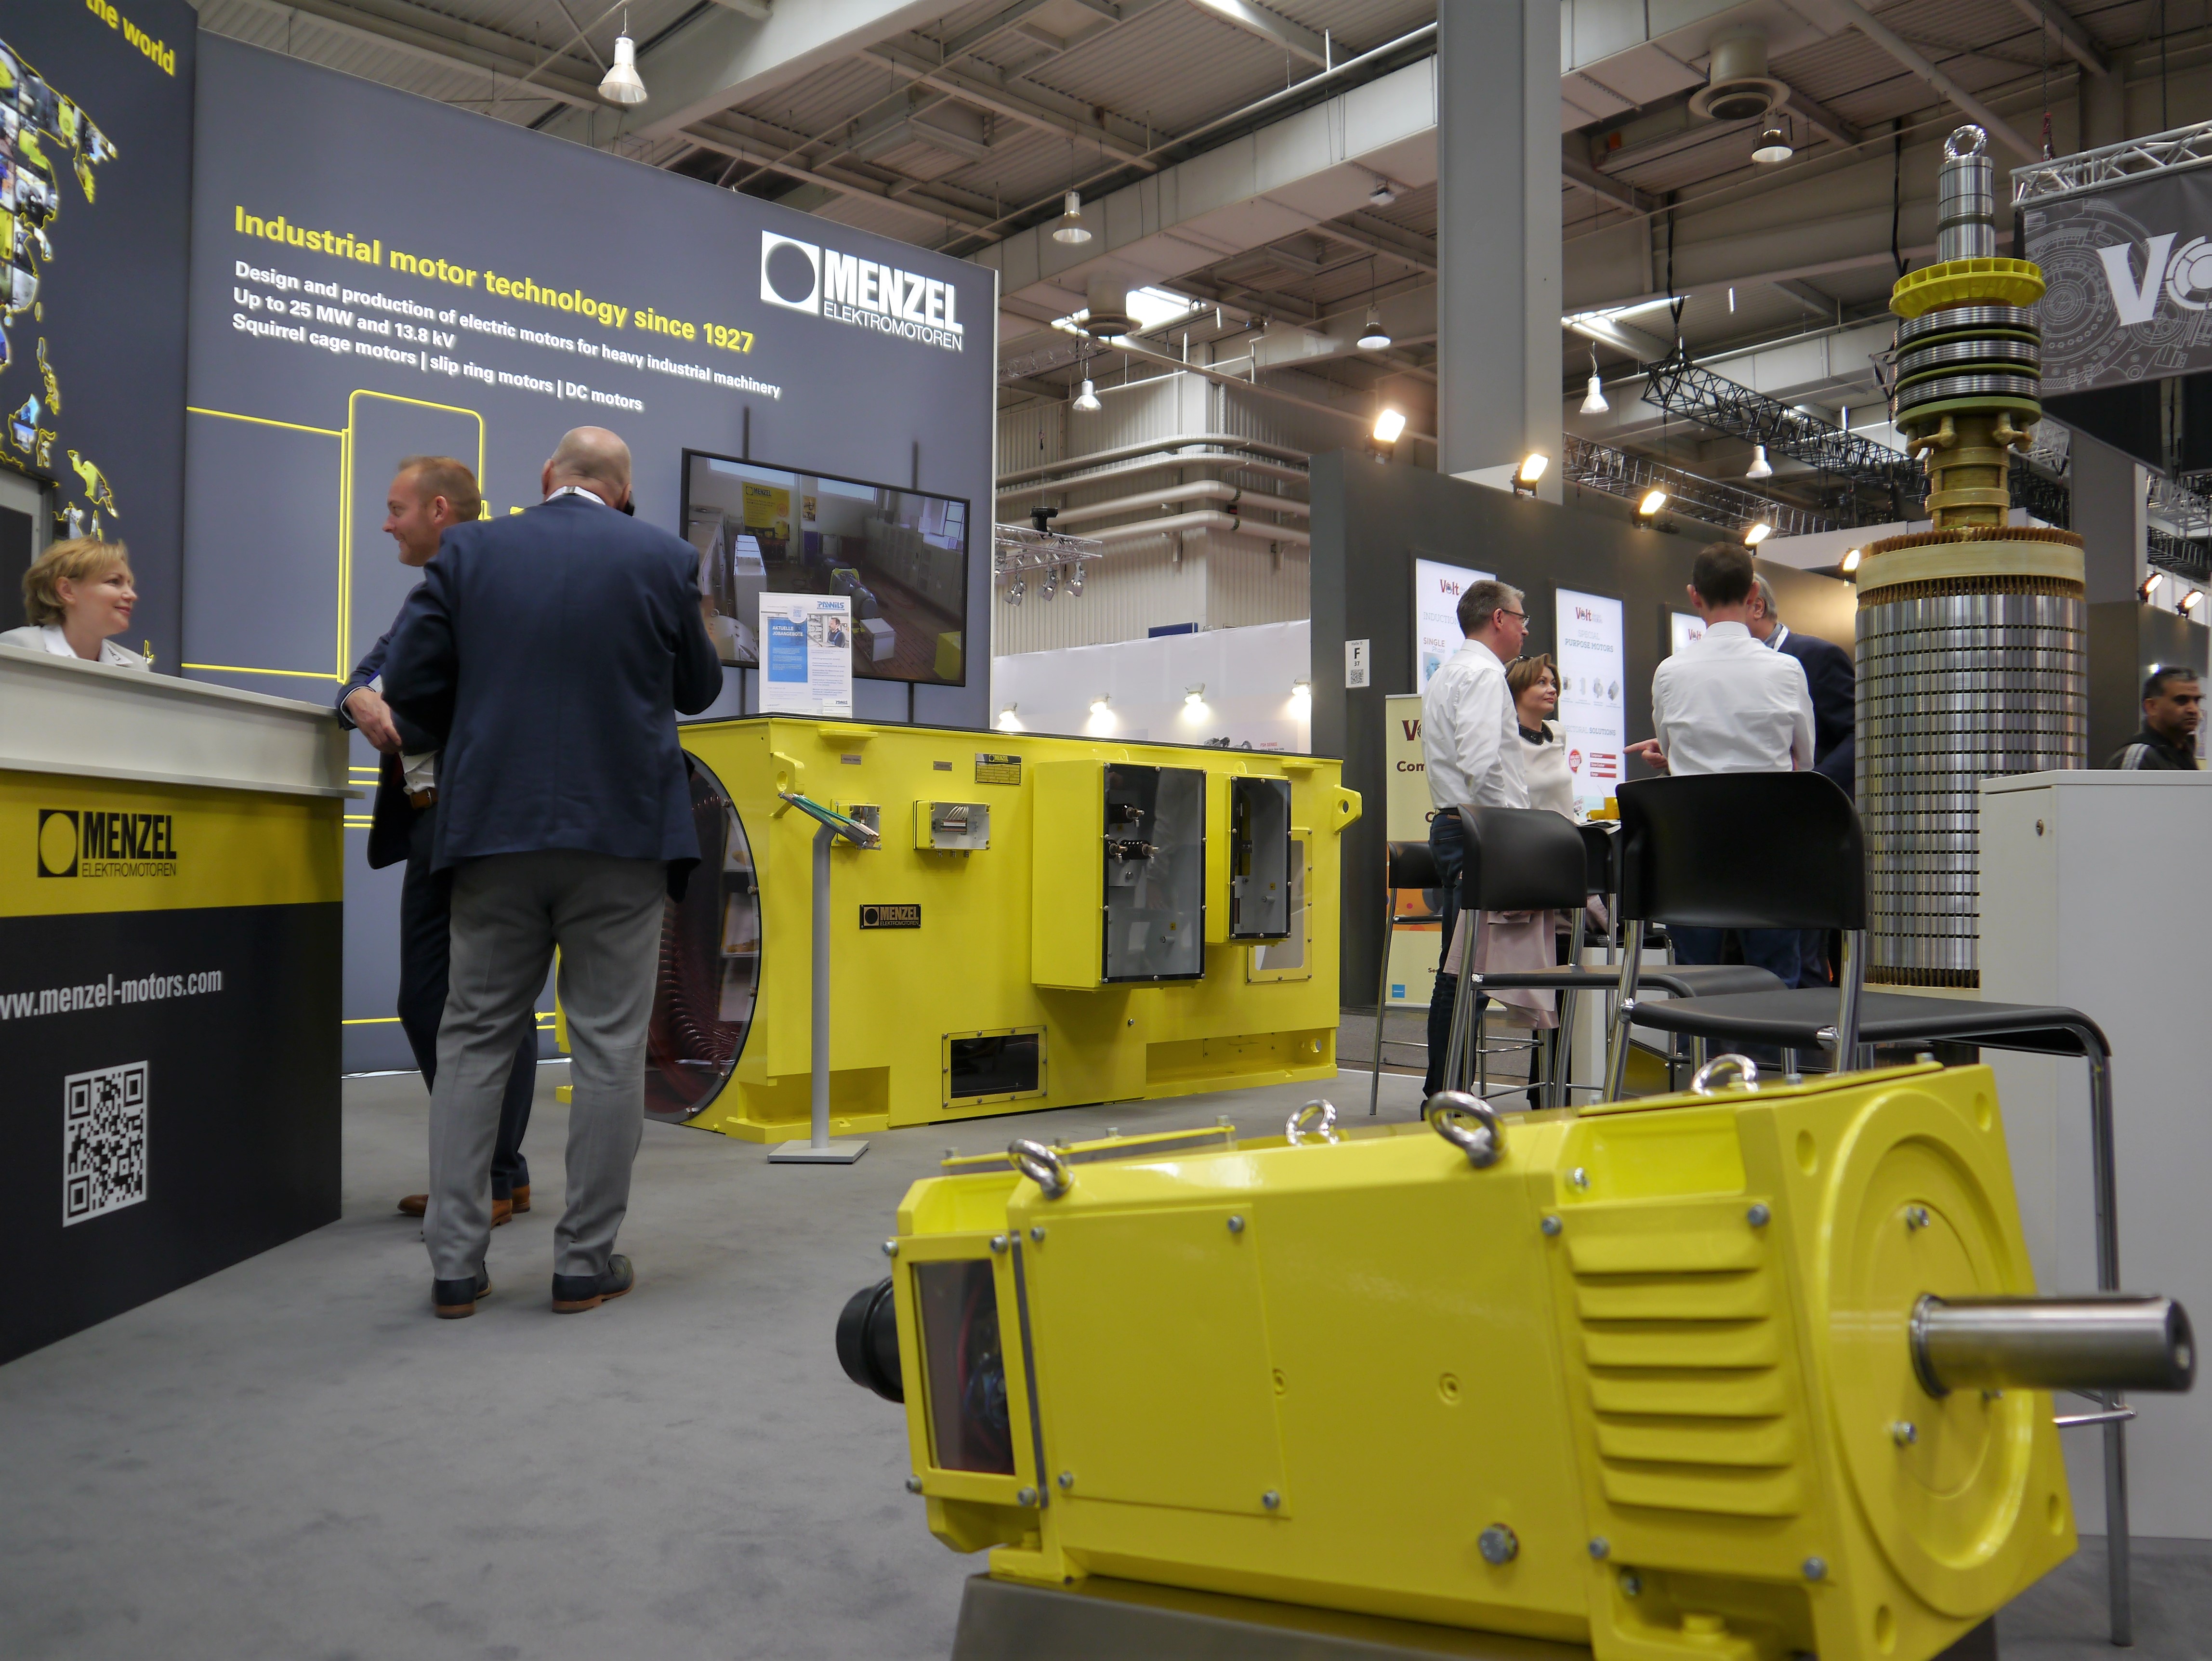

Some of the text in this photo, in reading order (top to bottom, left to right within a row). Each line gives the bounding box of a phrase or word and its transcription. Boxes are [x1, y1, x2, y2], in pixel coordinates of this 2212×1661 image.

[122, 16, 175, 76] world
[235, 205, 754, 353] Industrial motor technology since 1927
[824, 249, 962, 333] MENZEL
[234, 287, 455, 348] Up to 25 MW and 13.8 kV
[235, 260, 781, 398] Design and production of electric motors for heavy industrial machinery
[823, 301, 962, 350] ELEKTROMOTOREN
[232, 313, 304, 342] Squirrel
[309, 331, 350, 352] cage
[355, 338, 417, 365] motors
[429, 356, 459, 375] slip
[463, 361, 494, 383] ring
[498, 369, 553, 393] motors
[565, 381, 588, 400] DC
[591, 390, 643, 410] motors
[753, 488, 771, 496] MENZEL
[1423, 612, 1459, 625] INDUCTION
[1423, 637, 1445, 647] SINGLE
[1578, 630, 1600, 640] SPECIAL
[1565, 638, 1614, 652] PURPOSE MOTORS
[1354, 647, 1360, 659] F
[1590, 727, 1616, 736] SOLUTIONS
[82, 811, 176, 859] MENZEL
[82, 862, 176, 877] ELEKTROMOTOREN
[880, 907, 919, 921] MENZEL
